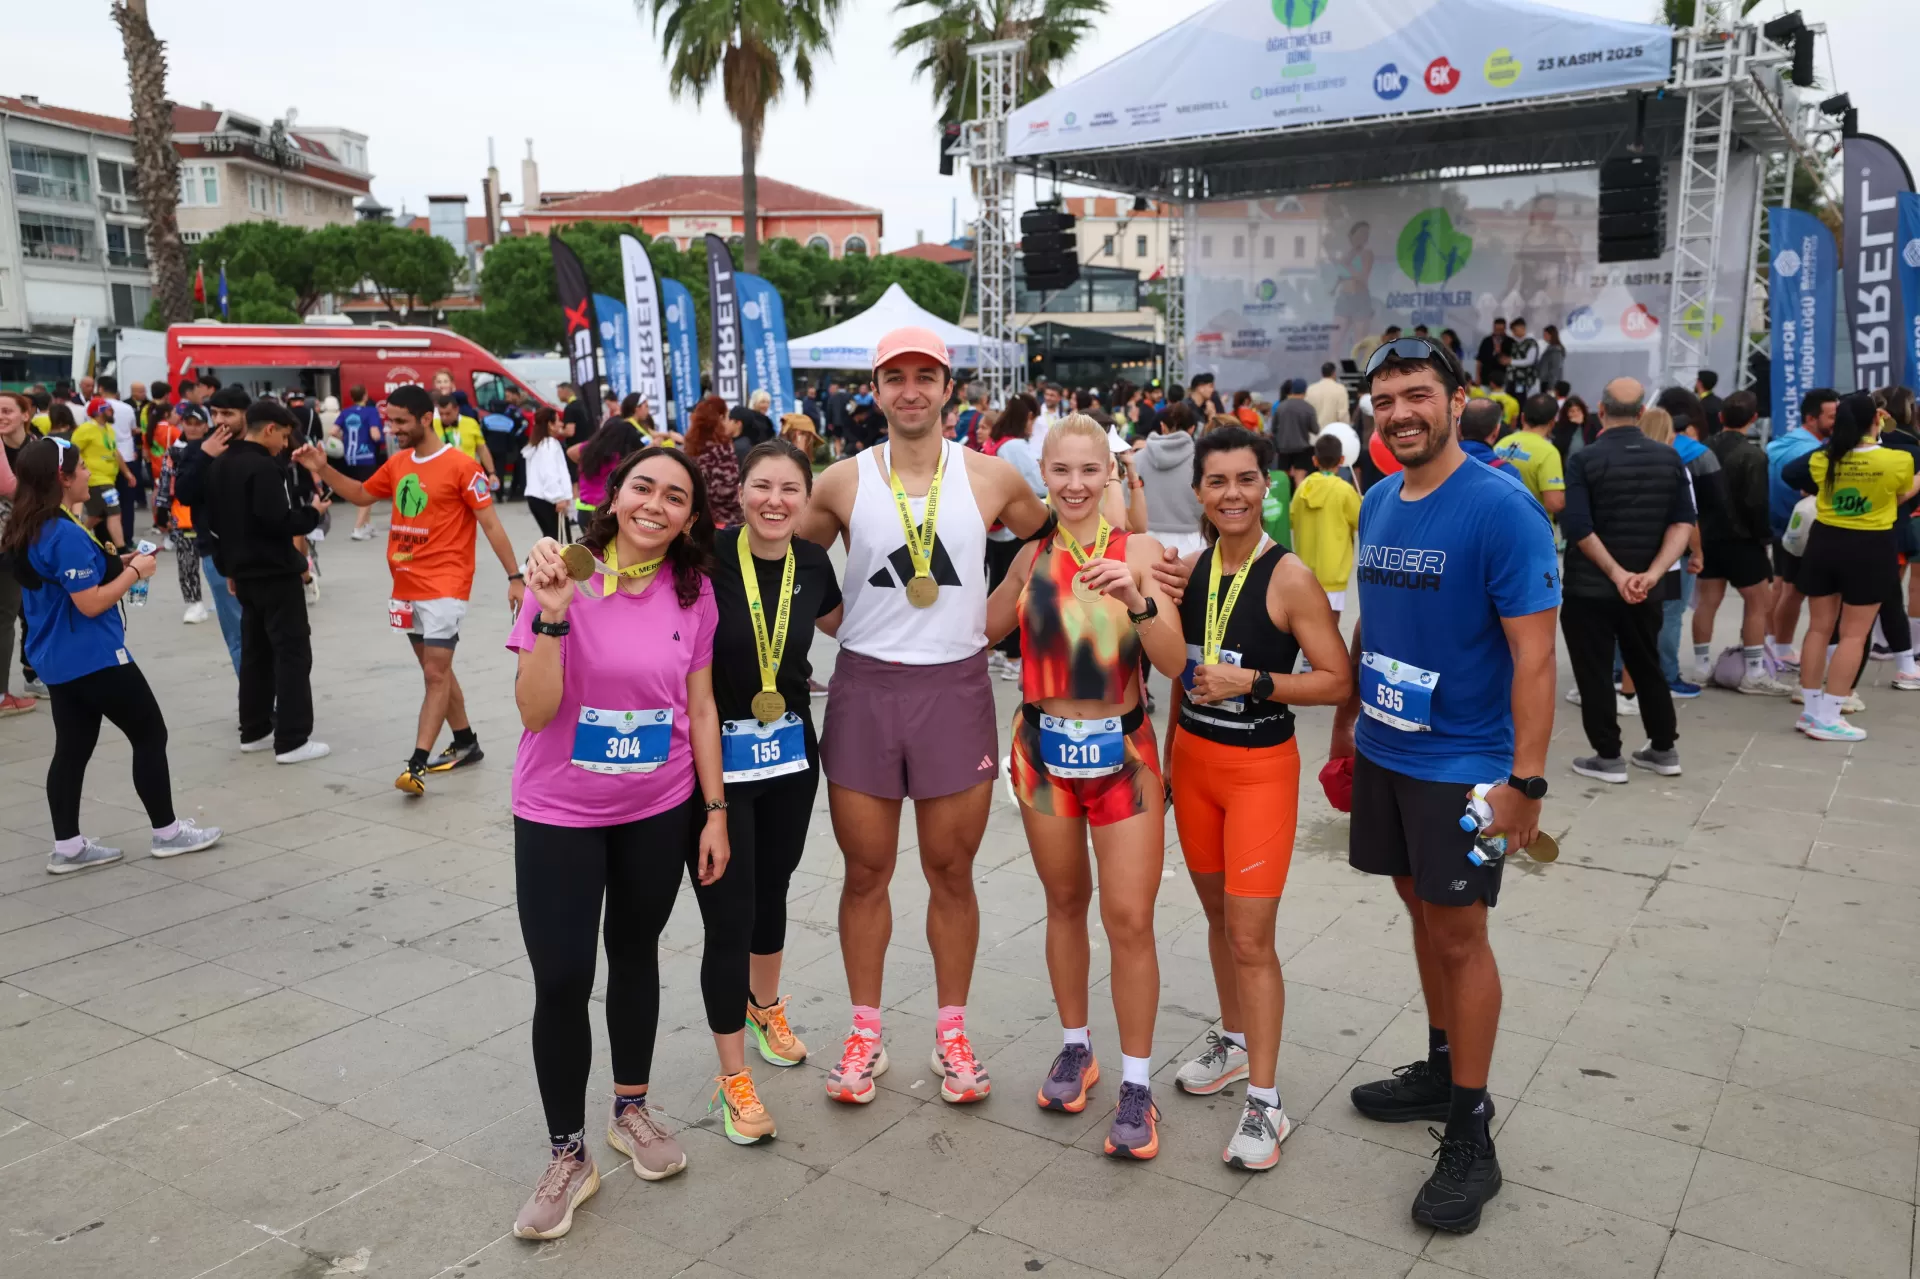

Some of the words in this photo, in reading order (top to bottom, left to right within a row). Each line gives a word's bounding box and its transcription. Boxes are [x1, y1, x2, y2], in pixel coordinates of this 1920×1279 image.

[1537, 57, 1555, 71] 23
[1557, 49, 1603, 69] KASIM
[1376, 72, 1402, 93] 10K
[1783, 320, 1796, 361] SPOR
[928, 486, 938, 517] BELEDİYESİ
[1835, 495, 1868, 513] 10K
[924, 518, 934, 546] BAKIRKÖY
[786, 551, 795, 587] MERREL
[1358, 544, 1447, 574] UNDER
[1357, 567, 1441, 593] ARMOUR
[778, 598, 789, 630] BELEDİYESİ
[1216, 613, 1228, 641] BAKIRKÖY
[1224, 583, 1240, 613] BELEDİYESİ
[772, 631, 785, 659] BAKIRKÖY
[1376, 683, 1404, 712] 535
[606, 736, 641, 759] 304
[751, 739, 781, 764] 155
[1058, 743, 1101, 764] 1210
